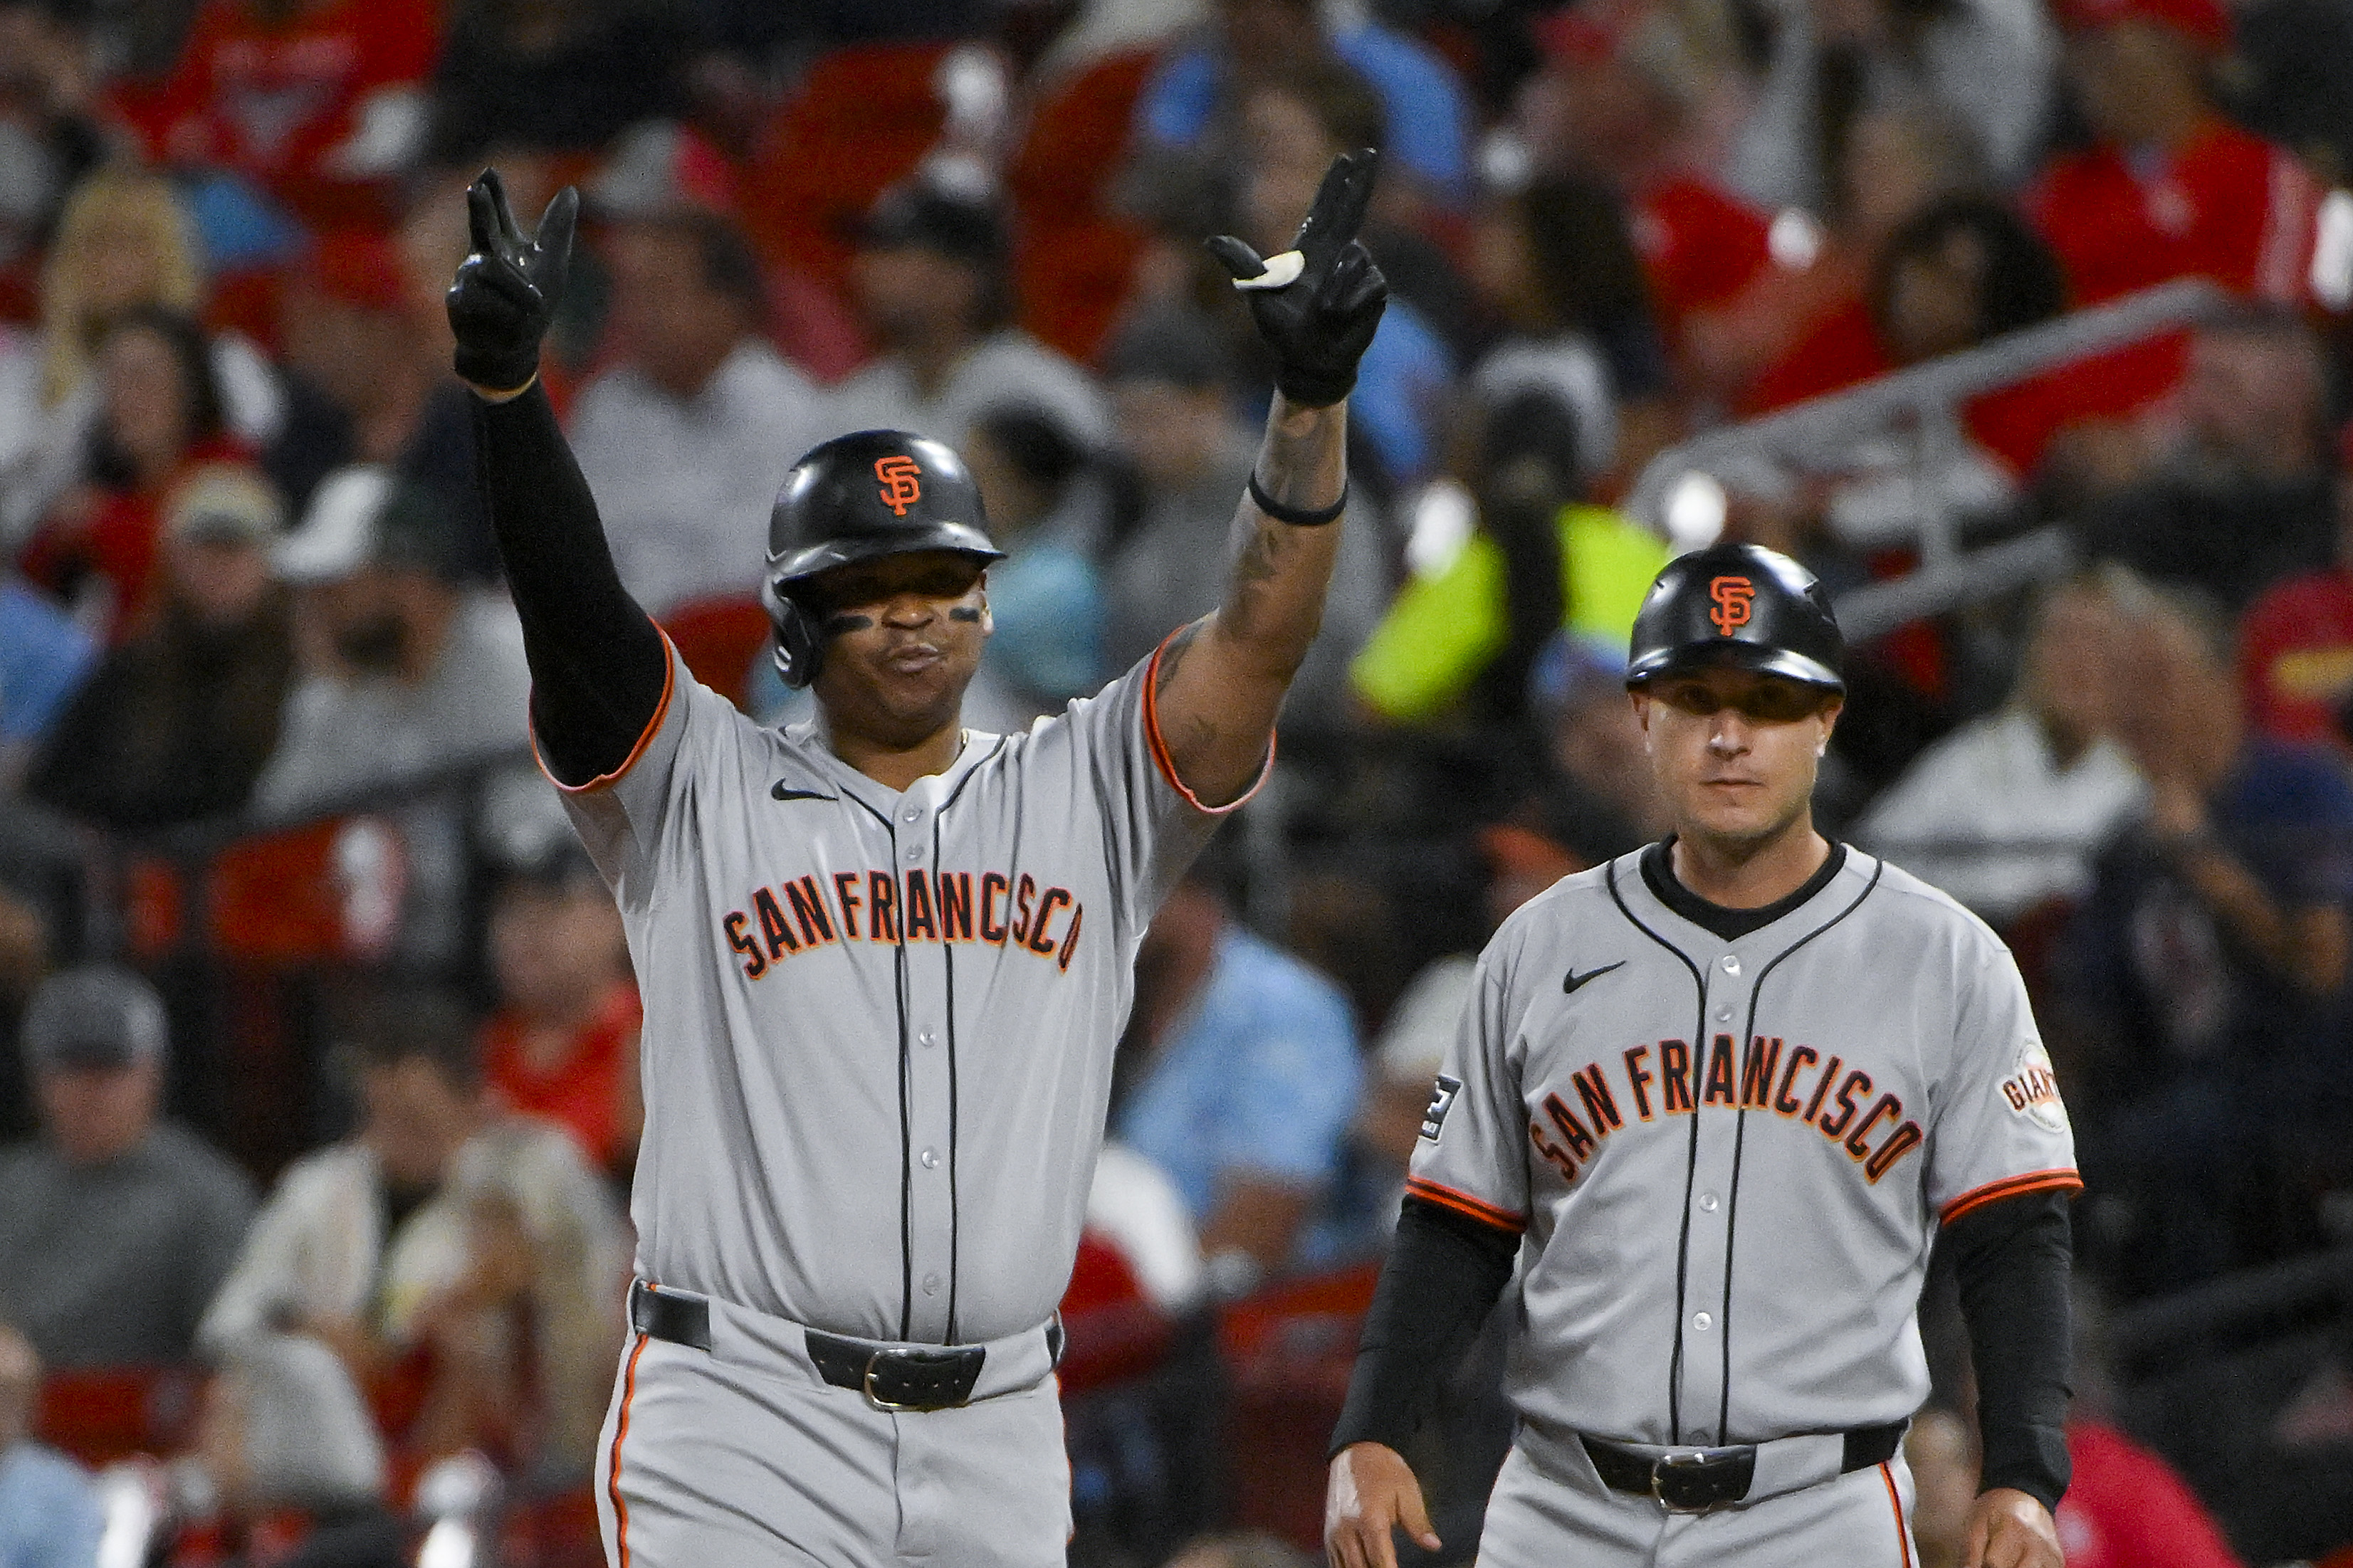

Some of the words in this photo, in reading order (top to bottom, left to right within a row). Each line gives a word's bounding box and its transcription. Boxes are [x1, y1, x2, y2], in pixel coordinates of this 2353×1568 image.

[874, 456, 921, 515] SF
[1710, 577, 1755, 636] SF
[723, 873, 837, 980] SAN
[1529, 1062, 1625, 1182] SAN
[1622, 1033, 1922, 1185] FRANCISCO
